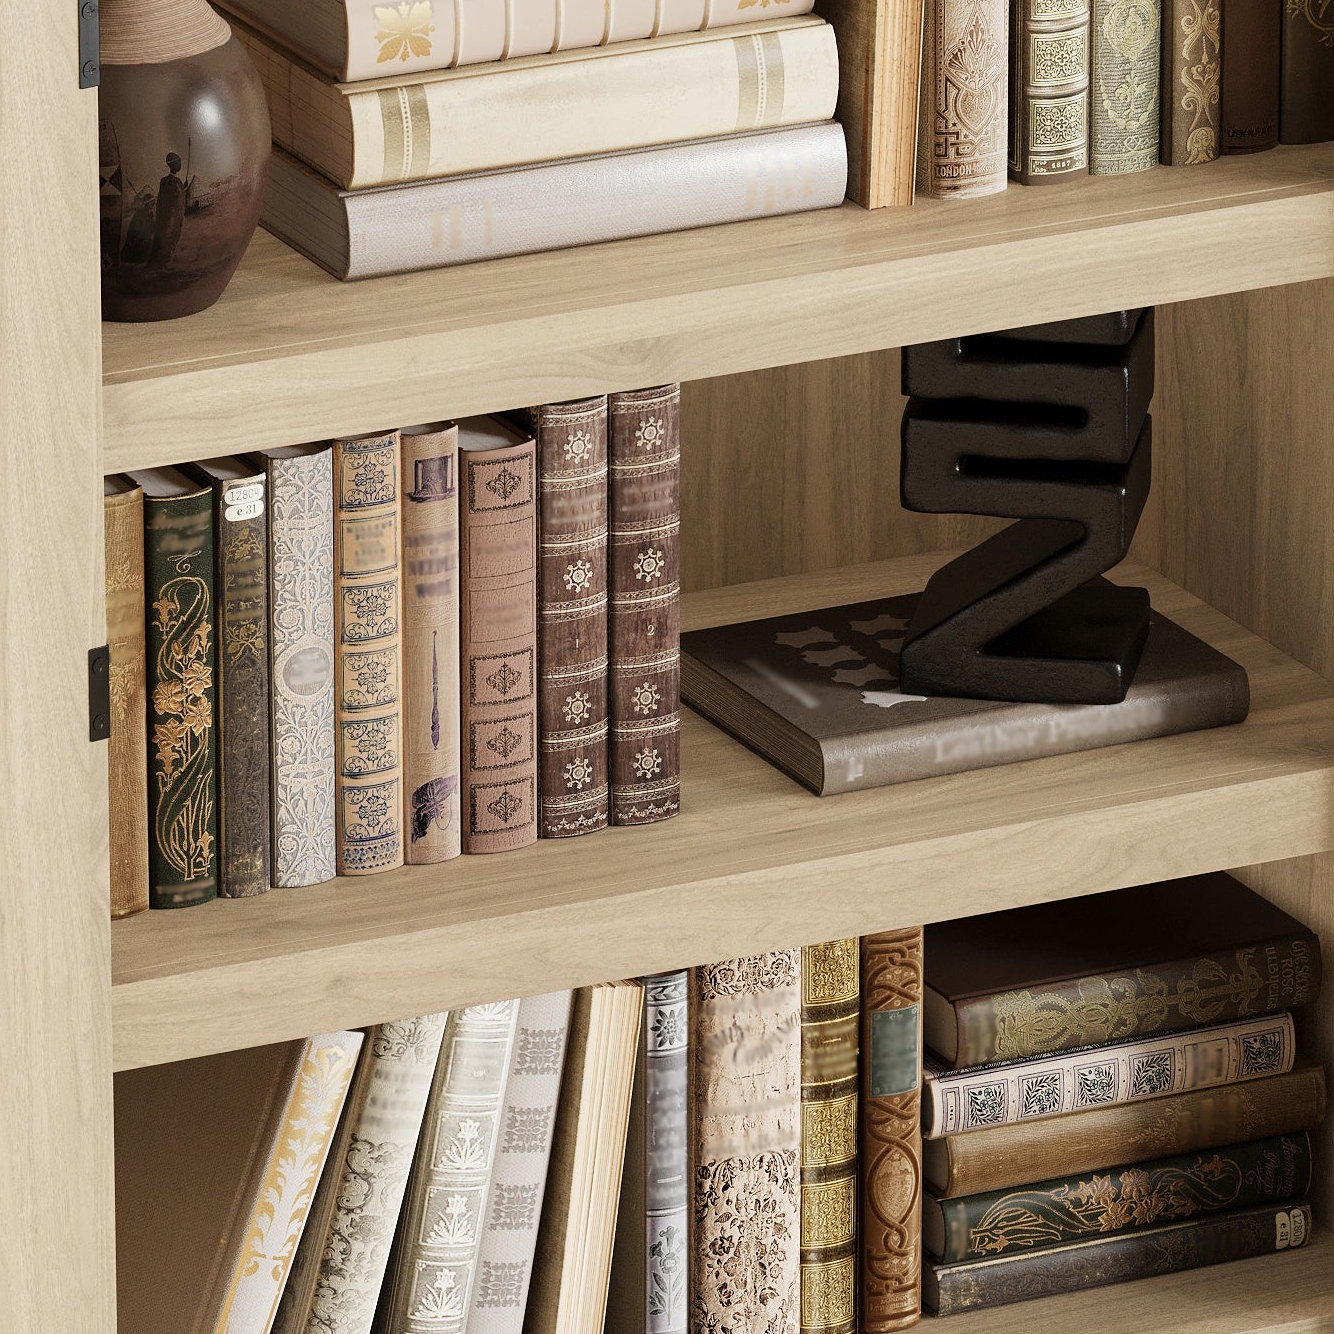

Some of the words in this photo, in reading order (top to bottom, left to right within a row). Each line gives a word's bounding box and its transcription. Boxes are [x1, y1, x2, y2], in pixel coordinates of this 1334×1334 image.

[935, 163, 972, 178] LONDON
[245, 504, 257, 515] 31
[646, 624, 655, 636] 2
